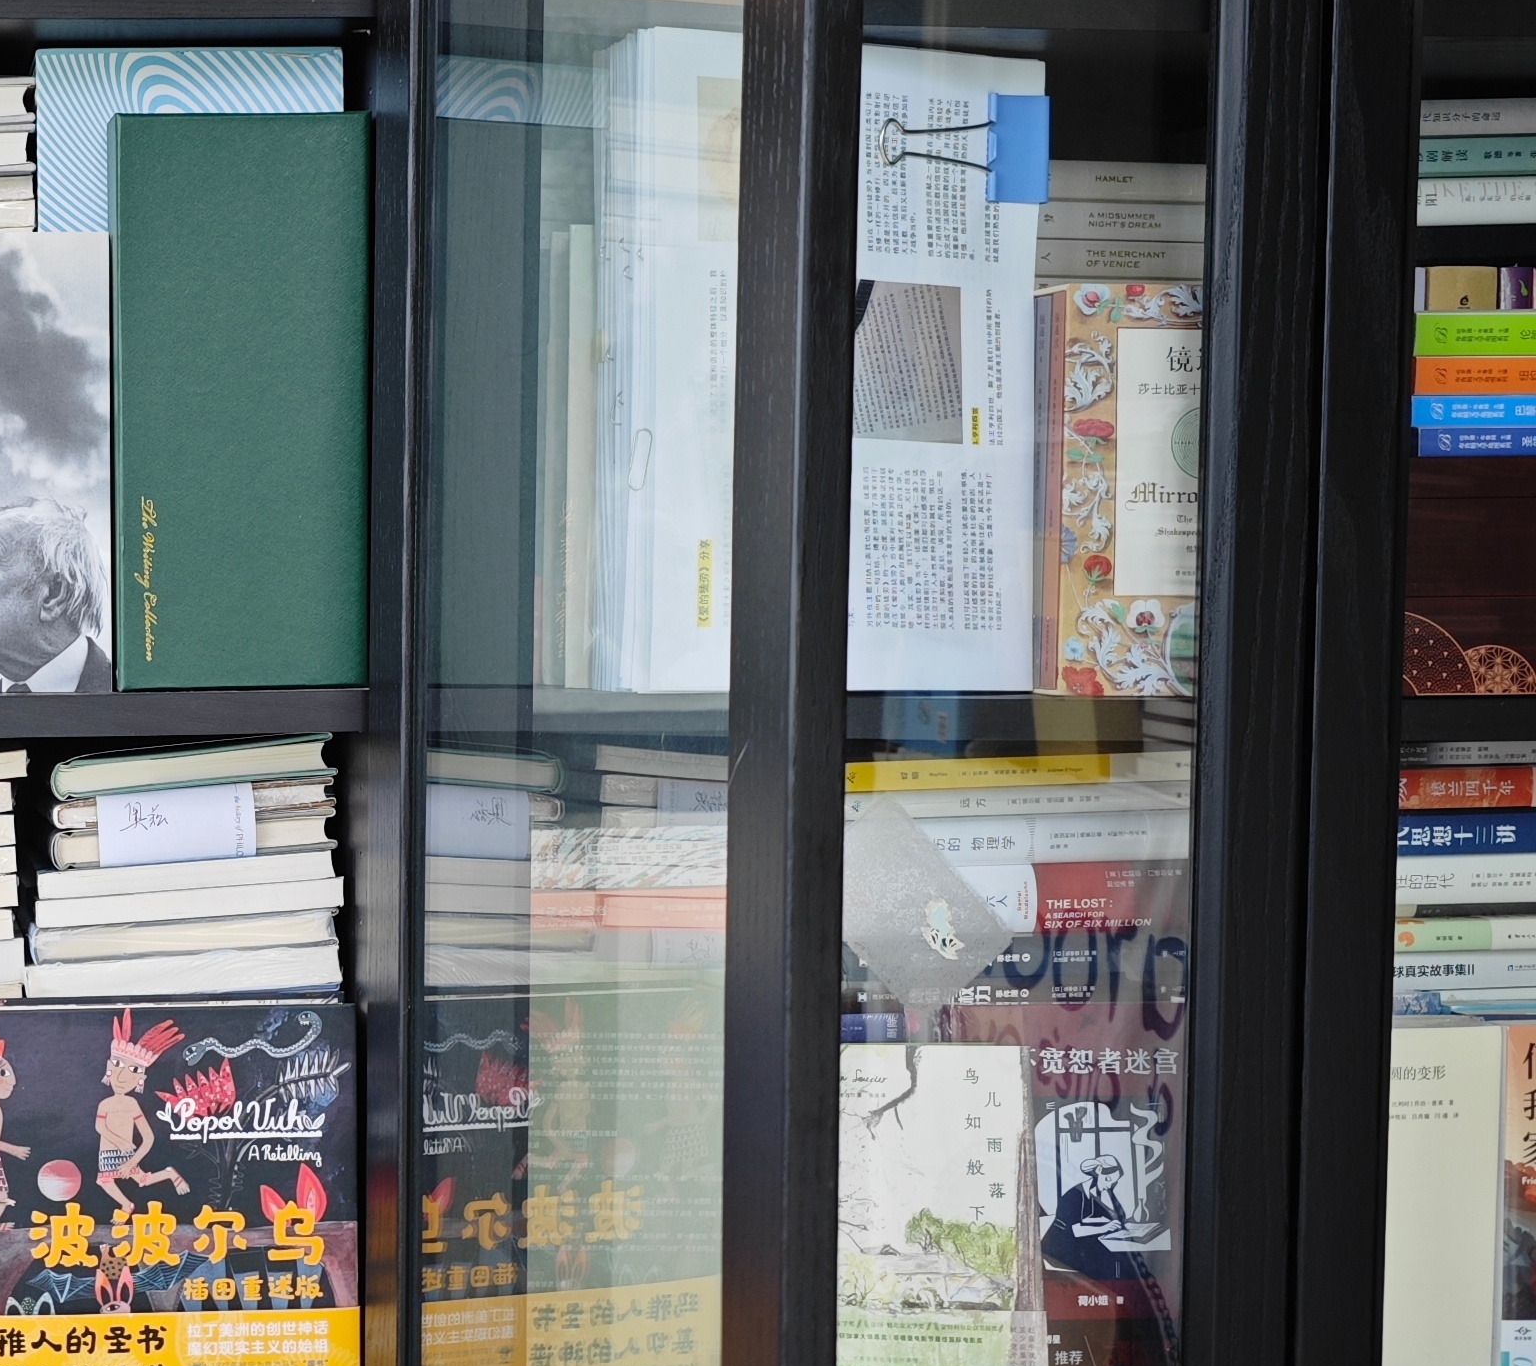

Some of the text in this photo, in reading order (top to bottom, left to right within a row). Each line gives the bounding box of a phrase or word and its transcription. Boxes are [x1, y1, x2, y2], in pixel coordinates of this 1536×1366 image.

[1095, 174, 1134, 184] HAMLET
[1088, 221, 1162, 230] NIGHT'S DREAM
[1086, 250, 1167, 259] THE MERCHANT
[1085, 259, 1141, 269] OF VENICE
[133, 495, 158, 662] The Writing Collection
[1429, 779, 1516, 797] 楼兰四千年
[959, 795, 987, 810] 远方
[971, 835, 1016, 851] 物理学
[1045, 898, 1106, 910] THE LOST
[1043, 918, 1153, 929] SIX OF SIX MILLION
[163, 1095, 305, 1144] Popol Vuh
[962, 1066, 1007, 1223] 鸟儿如雨般落下
[29, 1201, 326, 1268] 波波尔乌
[182, 1274, 325, 1302] 插图重述版
[187, 1321, 329, 1340] 拉丁美洲的创世神话
[187, 1339, 329, 1356] 魔幻现实主义的始祖
[1054, 1350, 1084, 1366] 推荐
